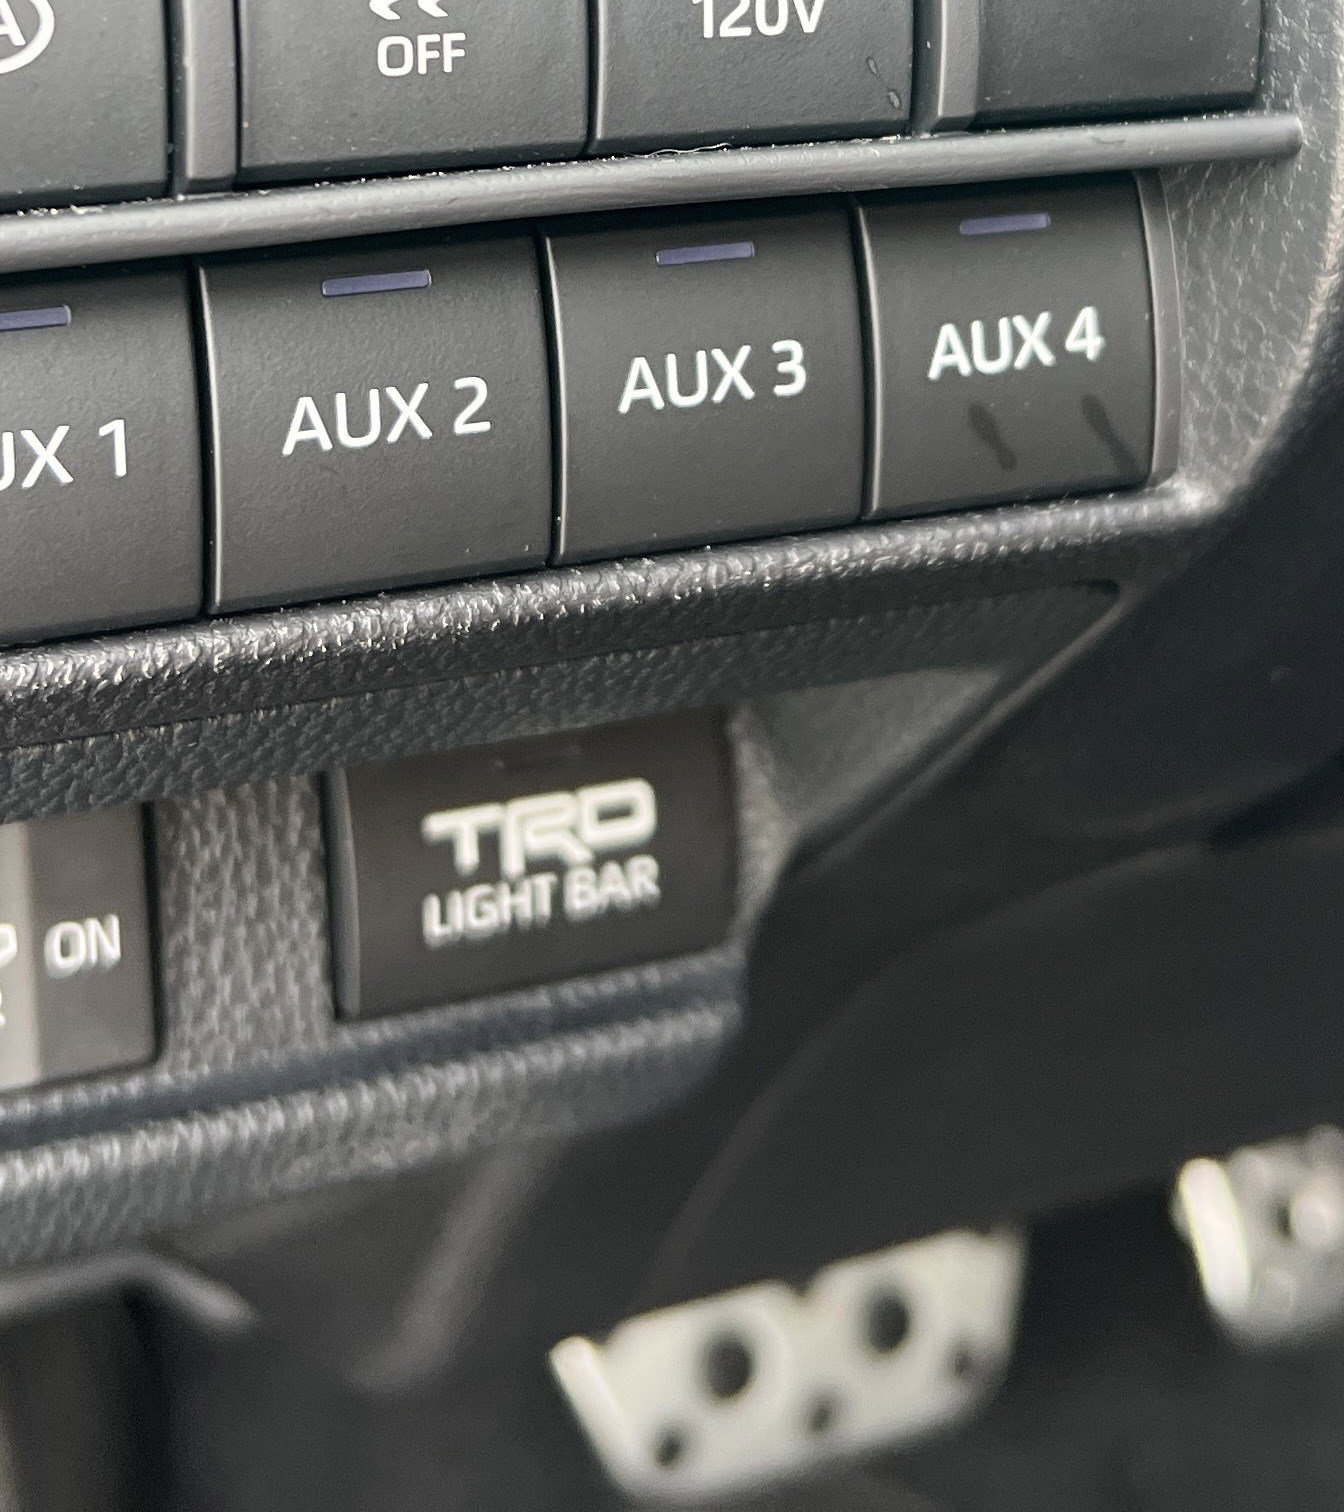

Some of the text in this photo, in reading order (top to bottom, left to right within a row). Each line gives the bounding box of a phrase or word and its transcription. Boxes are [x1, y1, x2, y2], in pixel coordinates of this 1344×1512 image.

[377, 33, 468, 76] OFF
[618, 340, 807, 414] AUX 3
[928, 306, 1105, 381] AUX 4
[98, 419, 129, 478] 1
[282, 376, 491, 457] AUX 2
[422, 778, 655, 877] TRD
[424, 855, 659, 948] LIGHT BAR
[45, 915, 123, 977] ON
